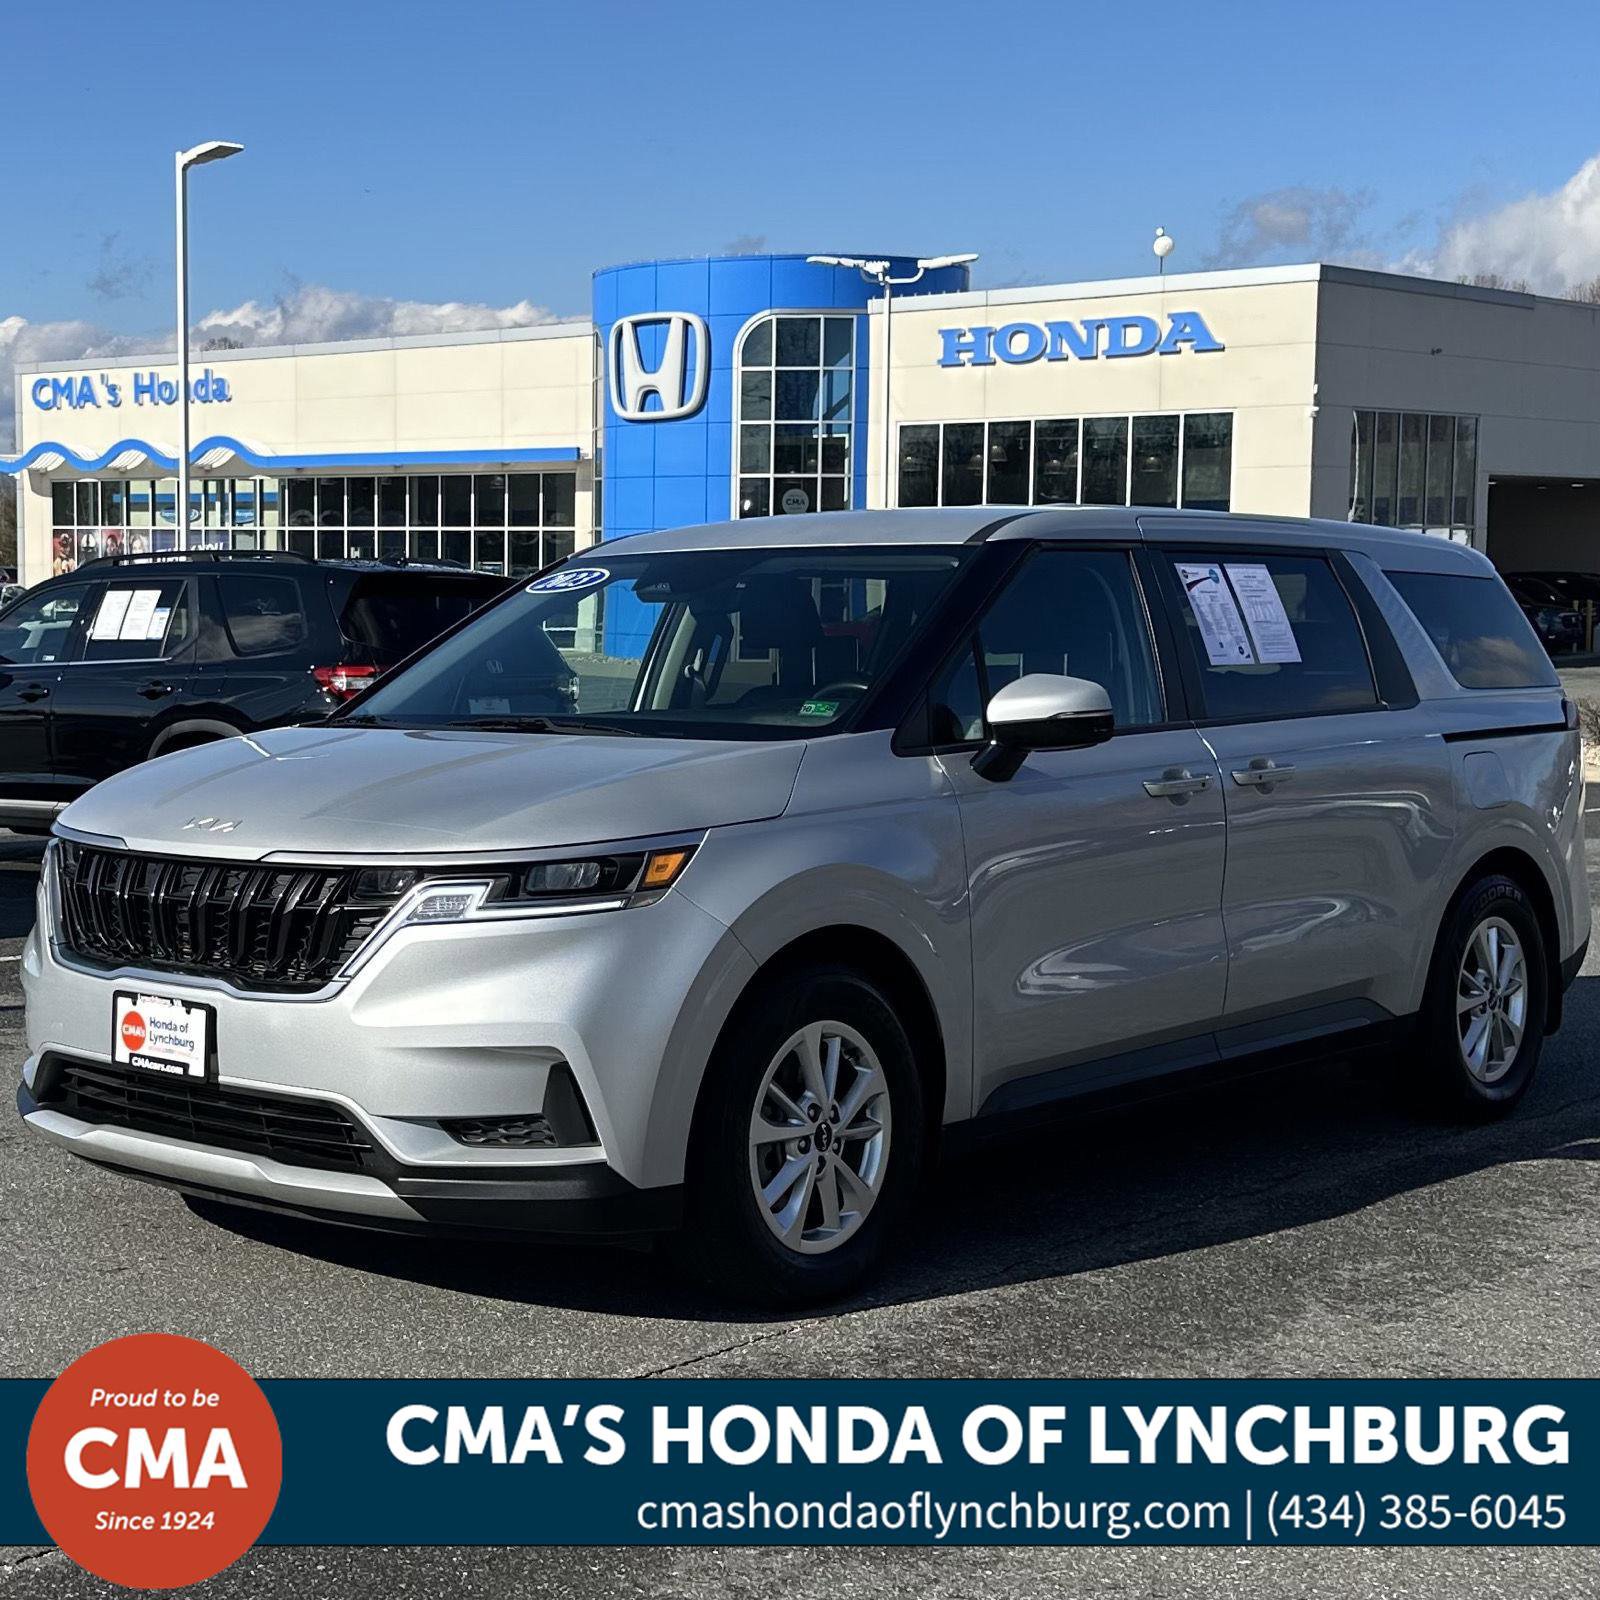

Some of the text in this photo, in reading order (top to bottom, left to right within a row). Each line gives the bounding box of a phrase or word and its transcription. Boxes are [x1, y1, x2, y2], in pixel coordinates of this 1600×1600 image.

[937, 311, 1225, 368] HONDA
[32, 368, 232, 411] CMA's Hoda
[149, 1017, 190, 1034] Honda of
[149, 1030, 195, 1052] Lynchburg
